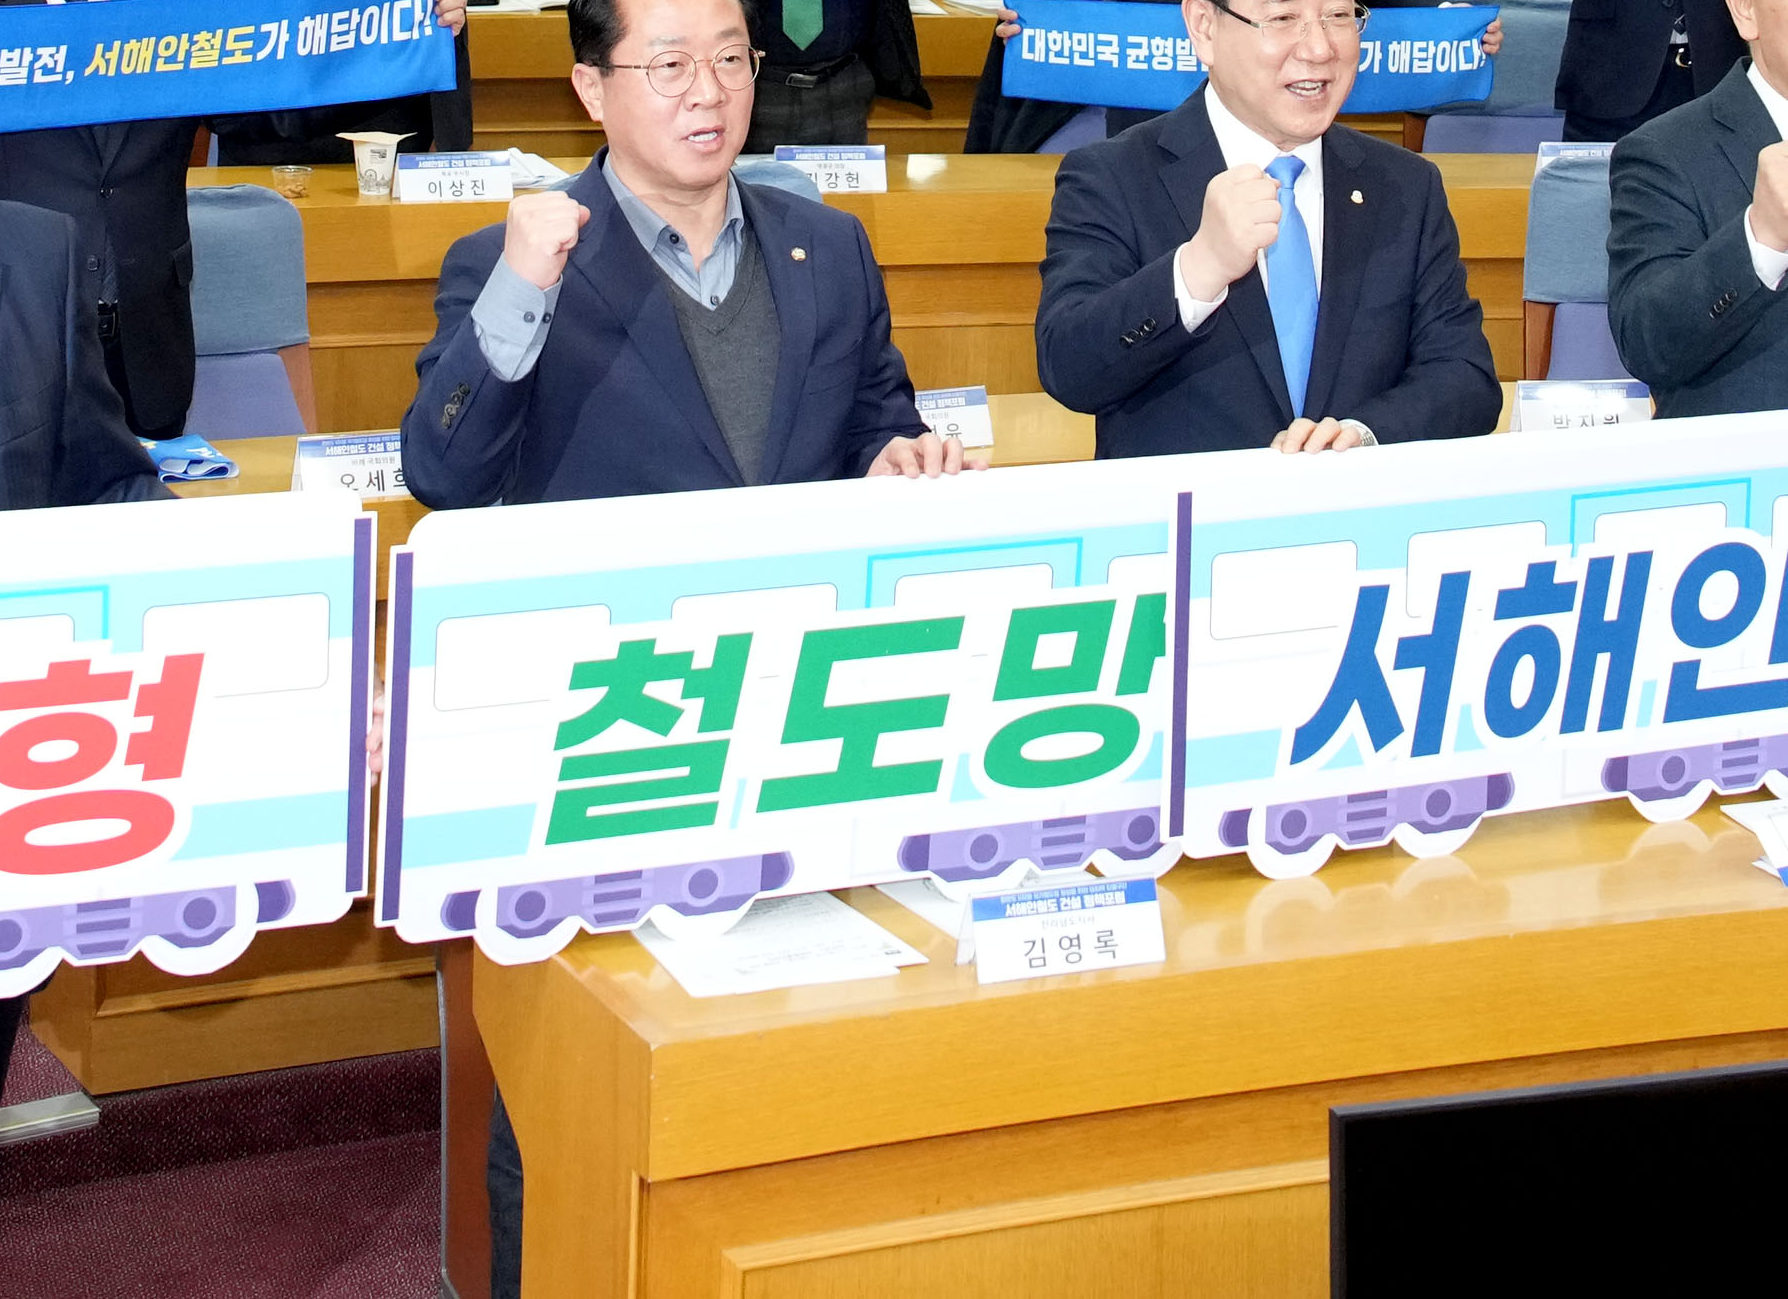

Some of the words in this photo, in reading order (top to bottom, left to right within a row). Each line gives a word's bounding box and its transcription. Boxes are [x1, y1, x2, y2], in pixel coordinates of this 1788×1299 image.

[84, 21, 290, 78] 서해안철도가
[1021, 27, 1118, 64] 대한민국
[1388, 38, 1487, 75] 해답이다!
[545, 593, 1167, 845] 철도망
